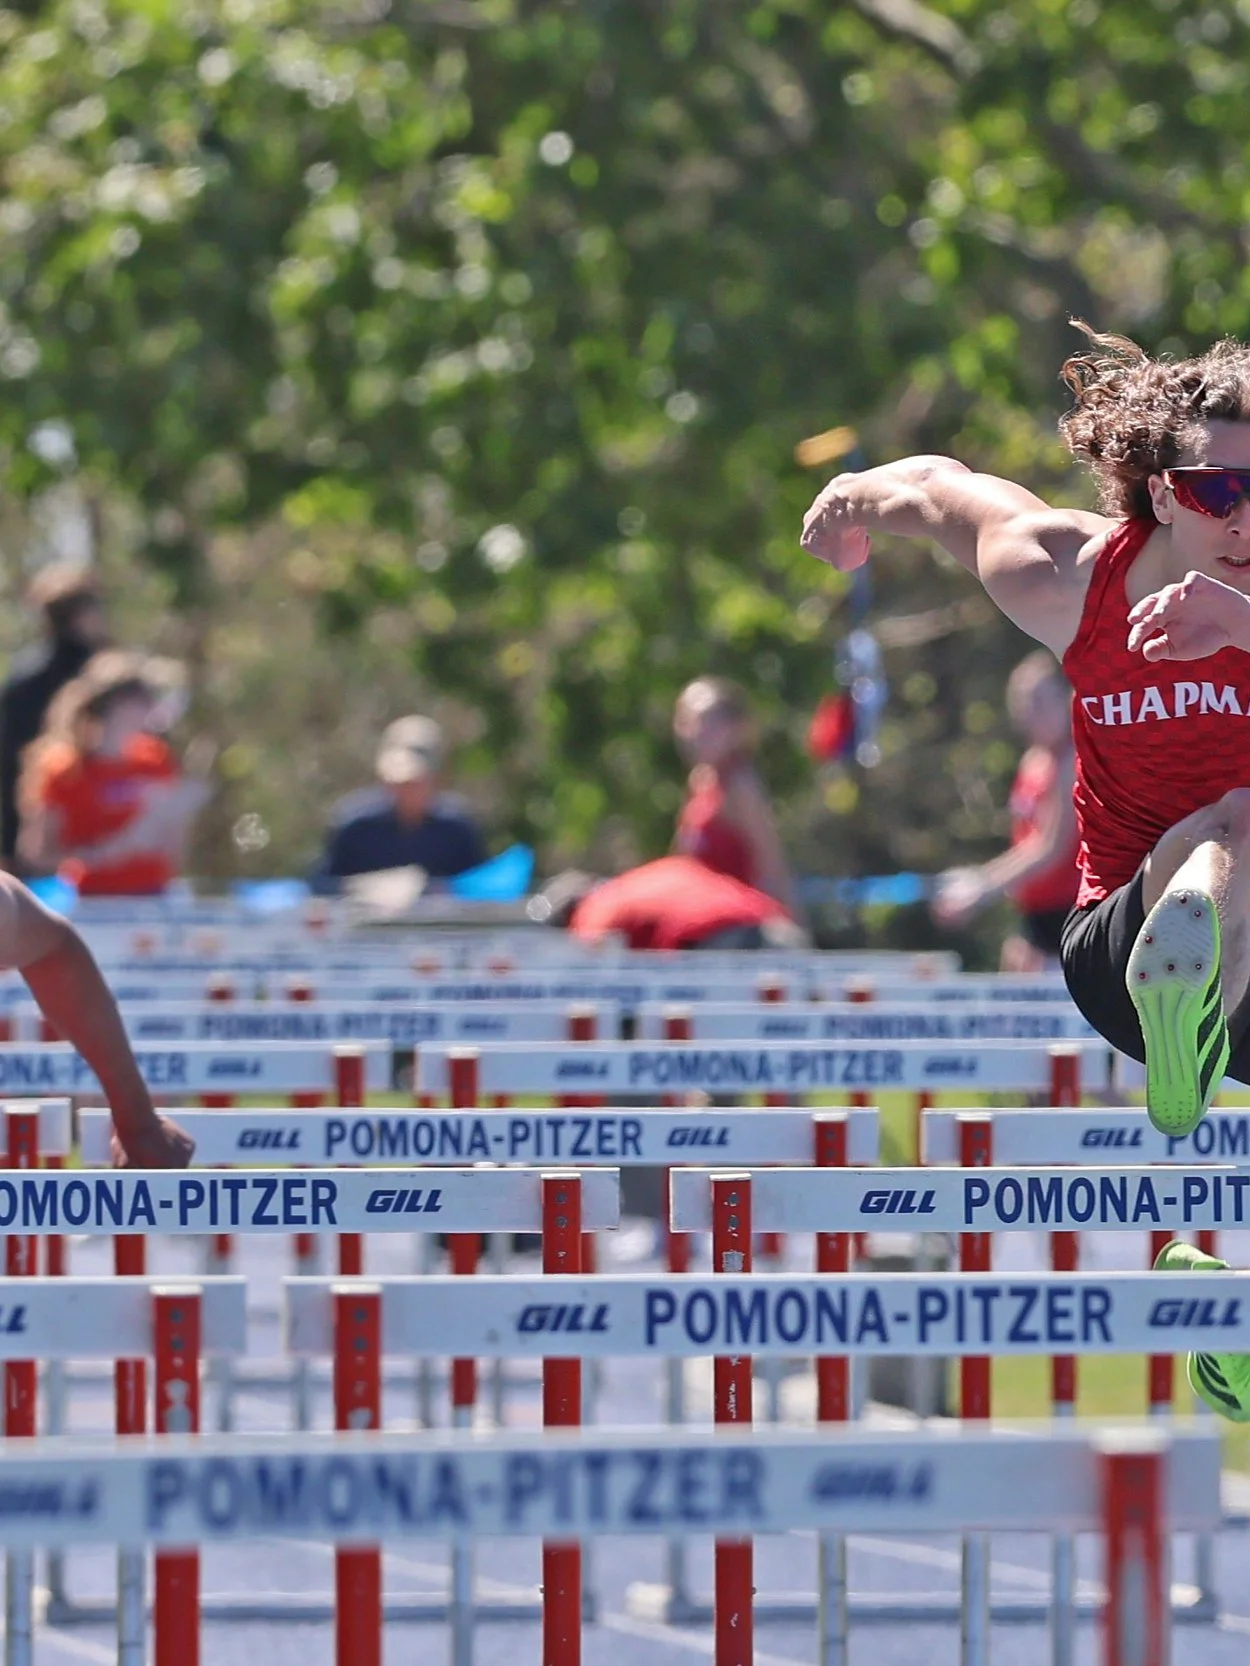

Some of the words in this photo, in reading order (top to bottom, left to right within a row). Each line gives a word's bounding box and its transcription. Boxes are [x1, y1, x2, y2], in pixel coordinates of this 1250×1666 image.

[630, 1051, 903, 1082] POMONA-PITZER
[237, 1130, 299, 1149] GILL
[325, 1119, 641, 1156] POMONA-PITZER
[667, 1128, 728, 1147] GILL
[1081, 1128, 1141, 1148] GILL
[366, 1190, 441, 1213] GILL
[860, 1191, 935, 1213] GILL
[517, 1305, 608, 1333] GILL
[646, 1286, 1112, 1344] POMONA-PITZER
[1148, 1299, 1240, 1327] GILL
[147, 1452, 764, 1527] POMONA-PITZER
